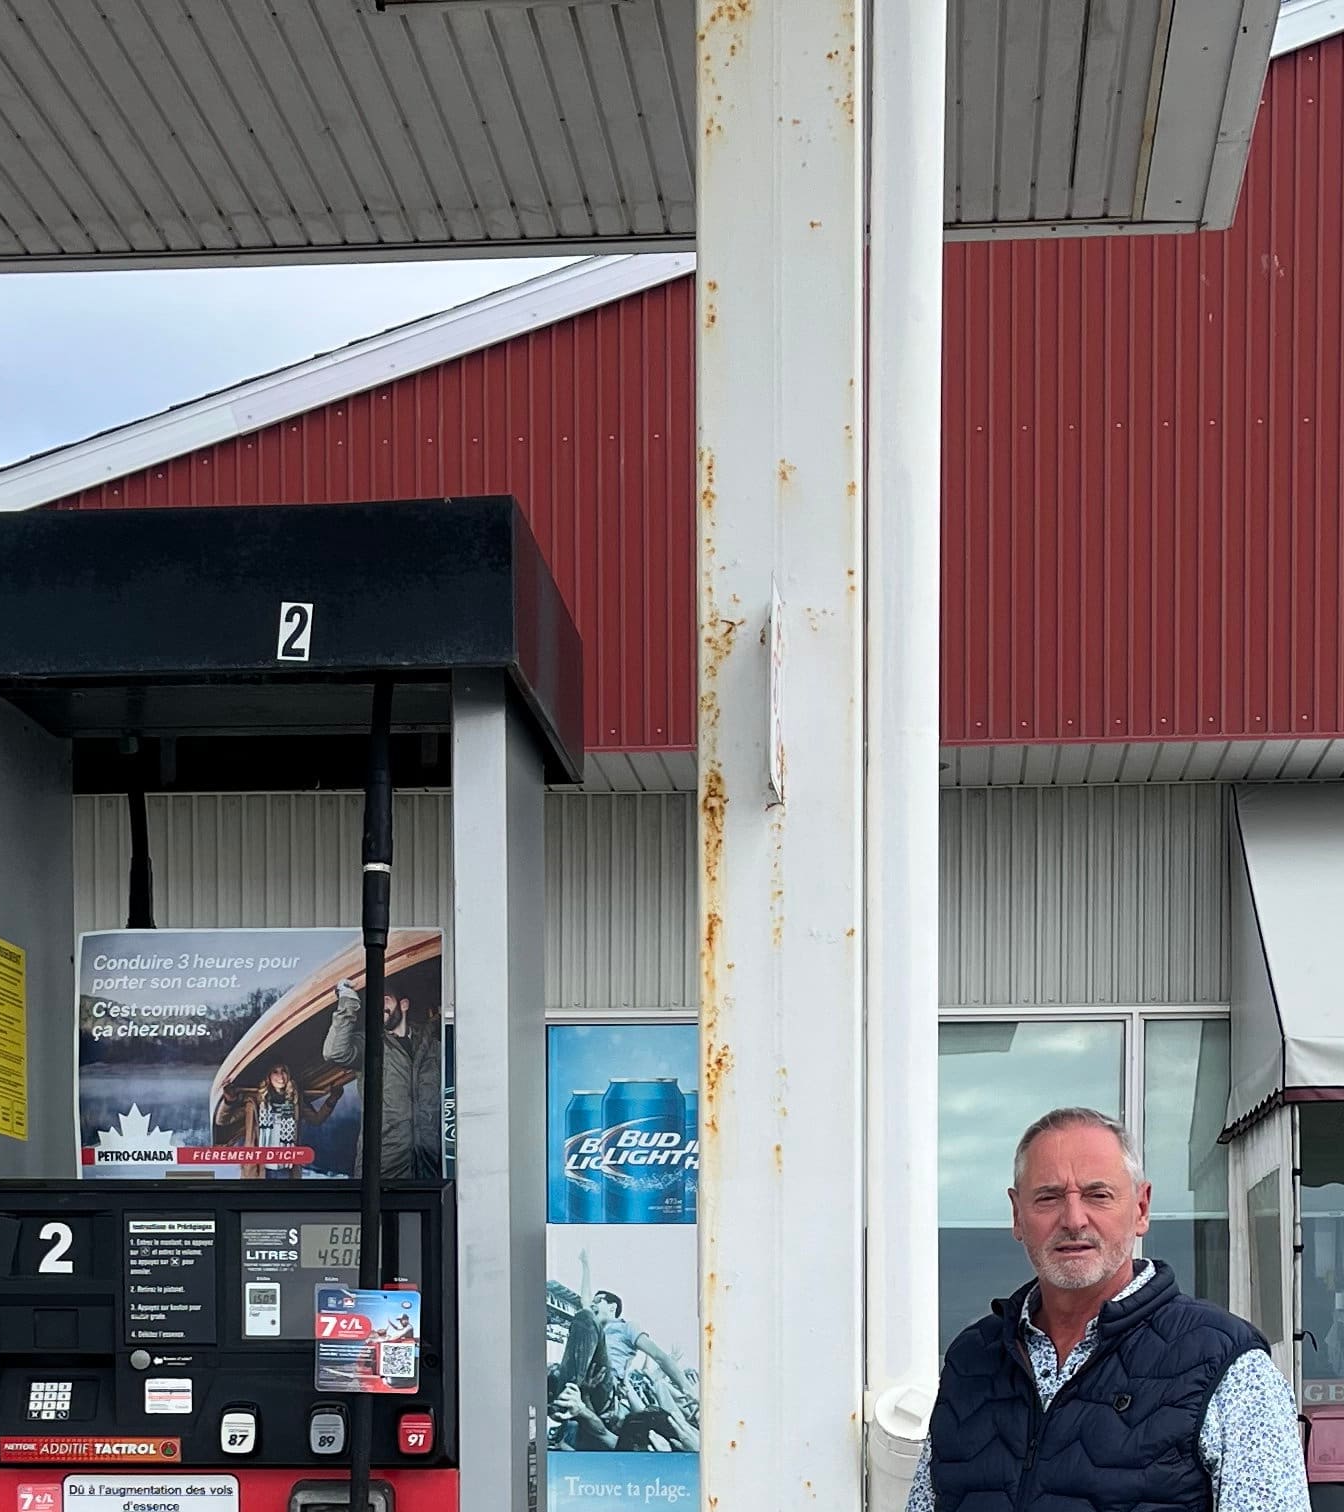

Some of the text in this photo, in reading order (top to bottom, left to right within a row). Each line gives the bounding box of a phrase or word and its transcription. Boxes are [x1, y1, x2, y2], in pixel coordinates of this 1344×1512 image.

[282, 605, 308, 657] 2
[93, 954, 300, 972] Conduire 3 heures pour
[92, 974, 241, 993] porter son canot.
[93, 1002, 207, 1018] C'est comme
[92, 1021, 211, 1042] ça chez nous.
[616, 1130, 681, 1147] BUD
[192, 1148, 261, 1161] FIÈREMENT
[602, 1148, 687, 1165] LIGHT
[289, 1228, 298, 1245] $
[39, 1222, 73, 1273] 2
[246, 1250, 298, 1260] LITRES
[320, 1316, 337, 1337] 7
[228, 1434, 249, 1446] 87
[318, 1436, 335, 1448] 89
[407, 1434, 425, 1447] 91
[40, 1443, 89, 1455] ADDITIF
[94, 1443, 157, 1455] TACTROL
[69, 1484, 233, 1497] Dû à l'augmentation des vols
[564, 1476, 691, 1504] Trouve ta plage.
[20, 1493, 34, 1510] 7
[123, 1502, 180, 1512] d'essence
